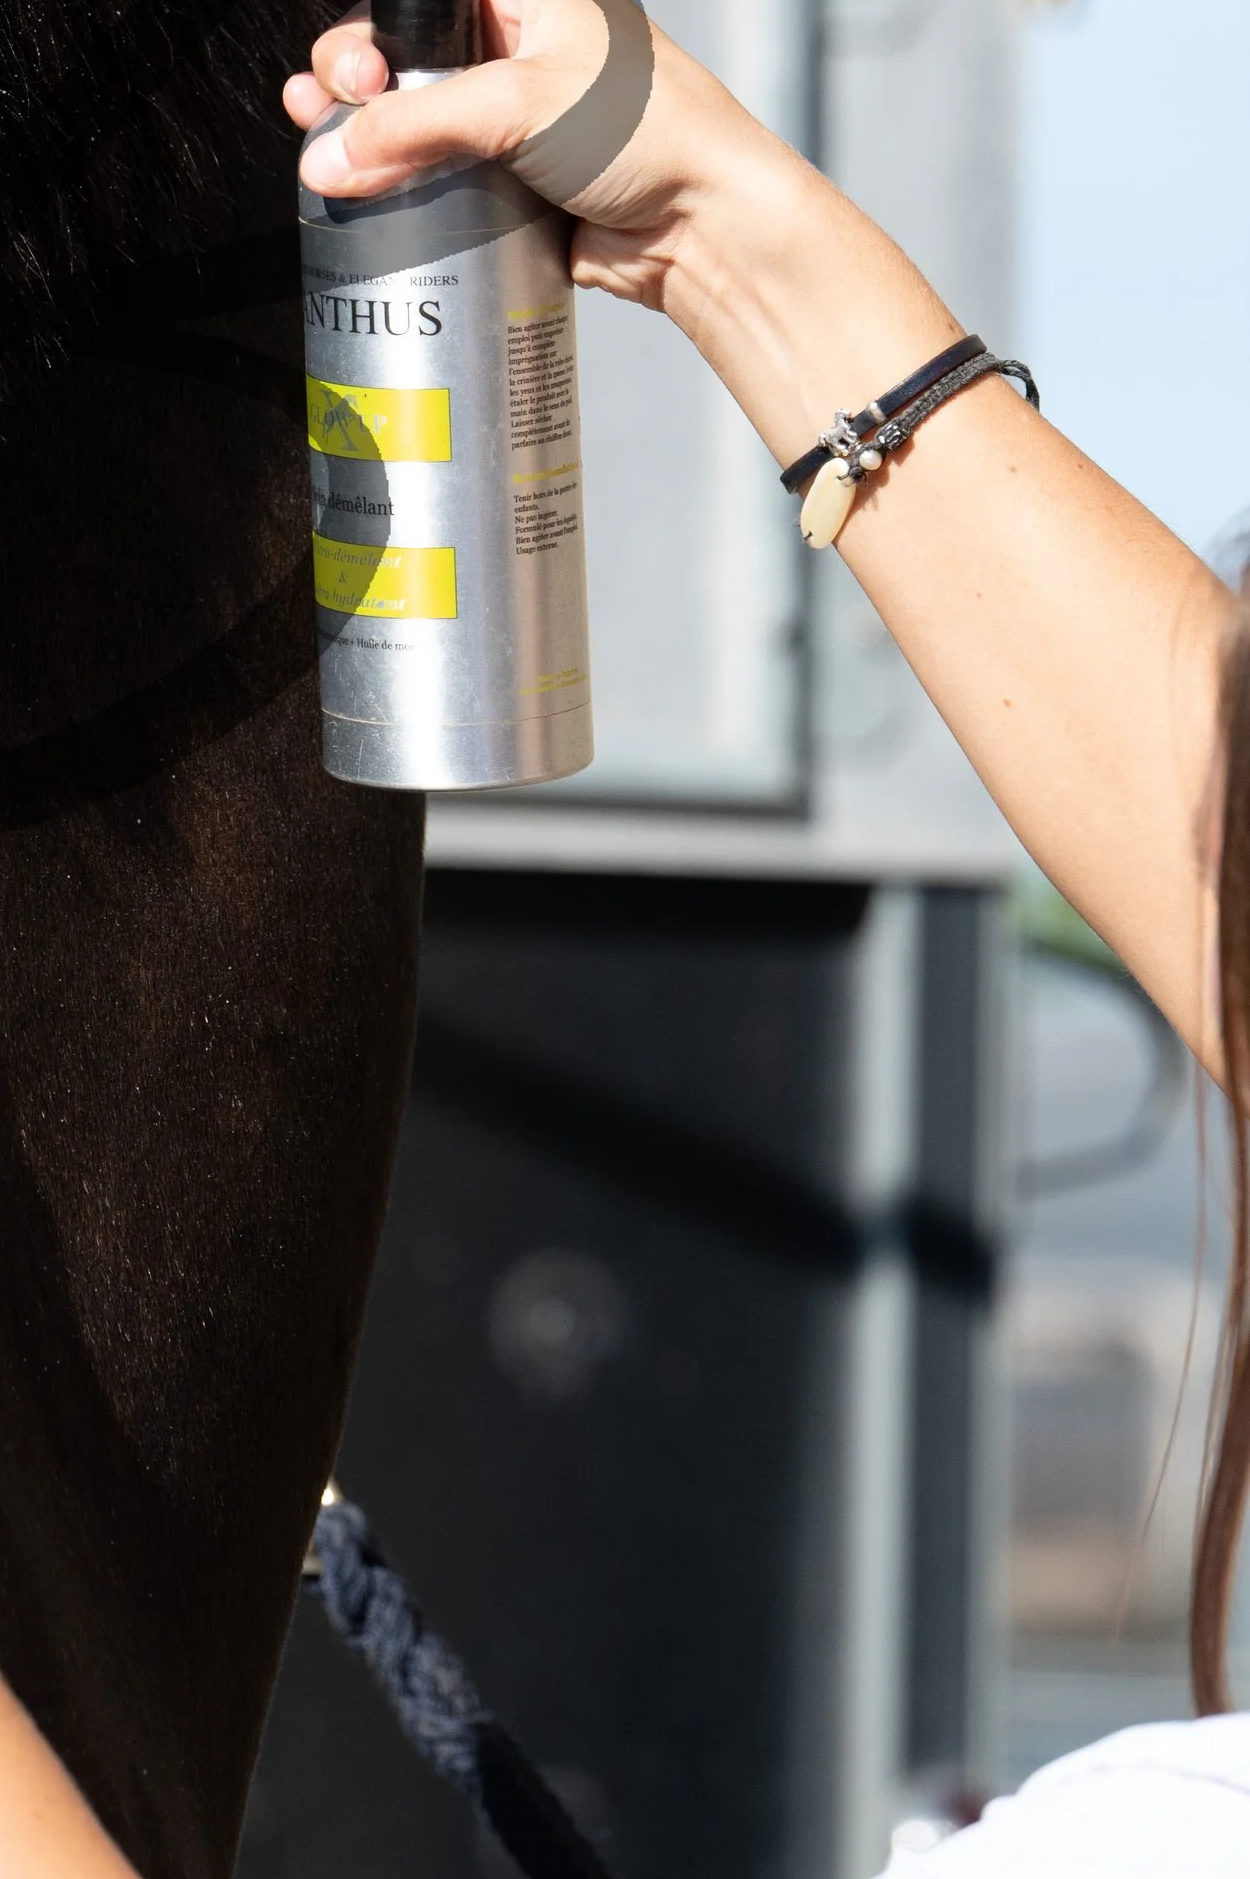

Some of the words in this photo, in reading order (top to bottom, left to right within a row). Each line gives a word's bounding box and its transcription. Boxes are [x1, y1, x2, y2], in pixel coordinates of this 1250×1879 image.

[339, 273, 348, 284] &
[410, 275, 459, 287] RIDERS
[328, 491, 395, 516] démêlant
[338, 571, 348, 584] &
[356, 637, 380, 650] Huile
[382, 640, 393, 651] de
